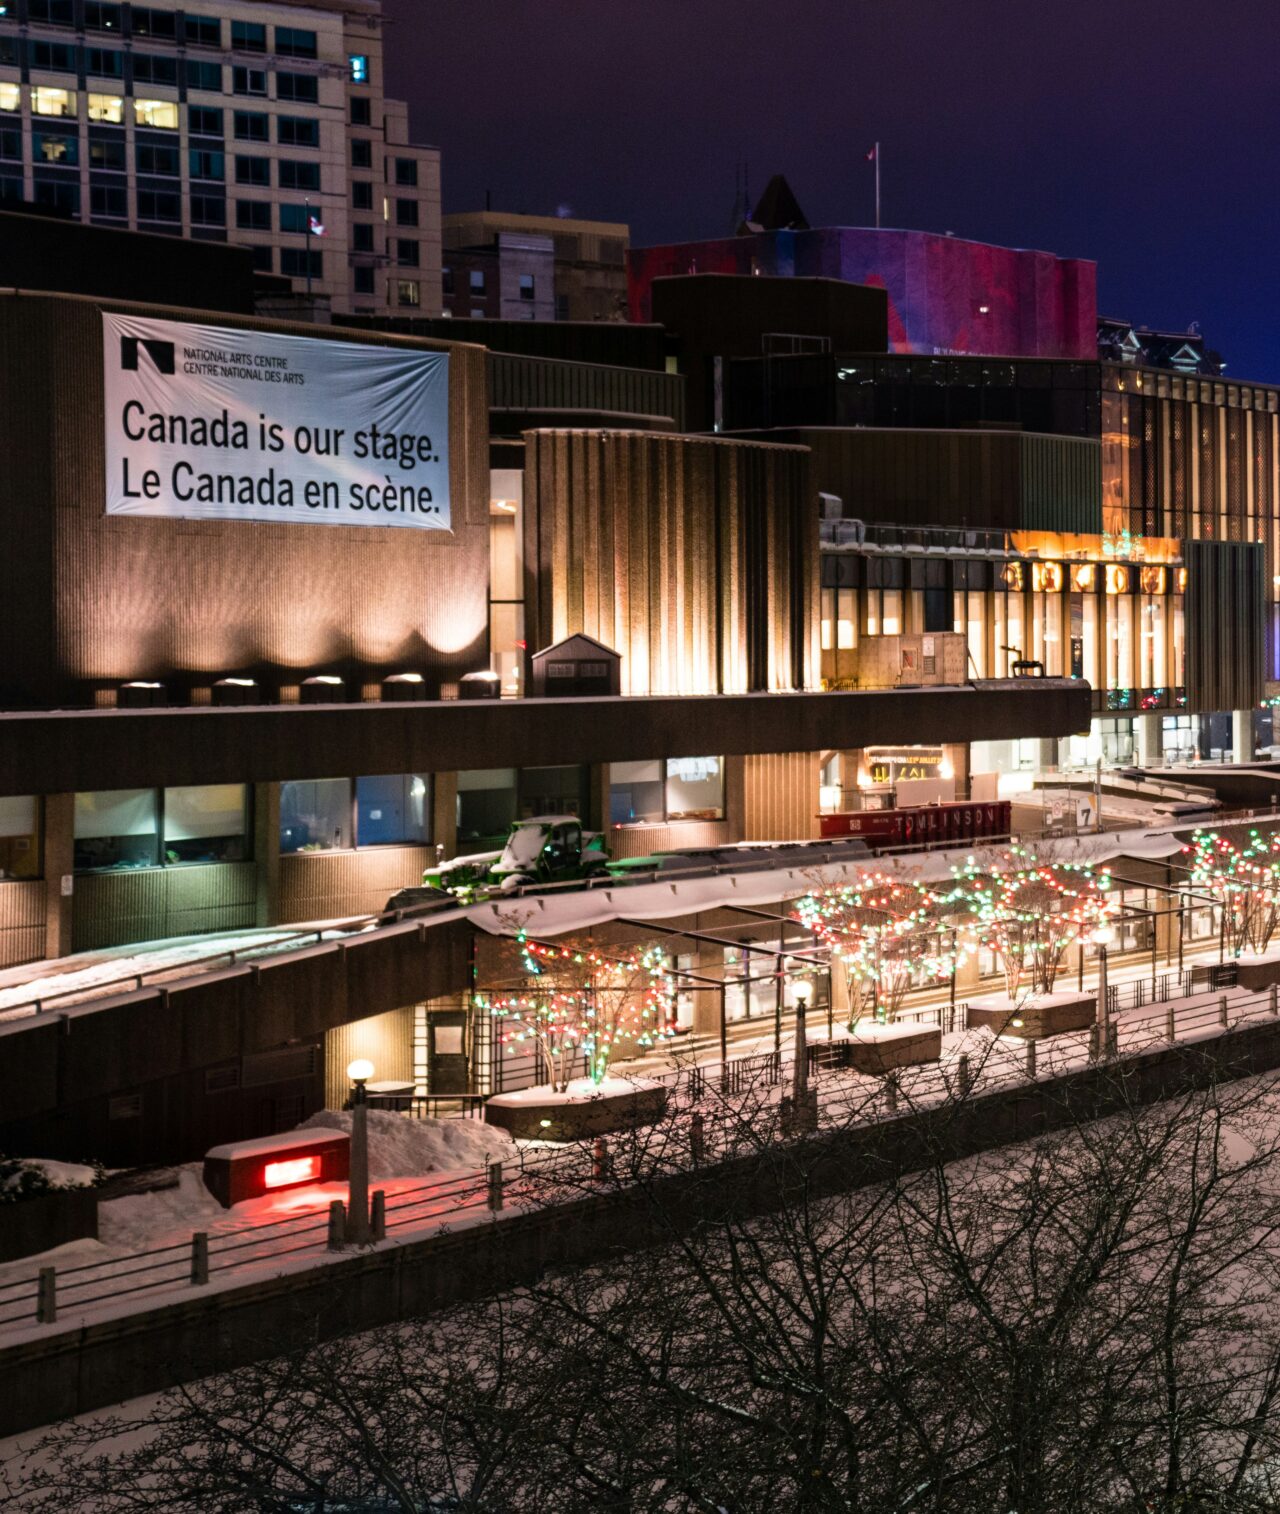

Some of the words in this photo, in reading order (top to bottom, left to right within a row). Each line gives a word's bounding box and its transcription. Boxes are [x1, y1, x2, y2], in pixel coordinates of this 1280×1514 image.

[183, 348, 228, 363] NATIONAL
[229, 352, 253, 366] ARTS
[254, 355, 288, 369] CENTRE
[183, 362, 219, 377] CENTRE
[220, 365, 263, 381] NATIONAL
[264, 370, 281, 383] DES
[282, 373, 305, 385] ARTS
[121, 399, 249, 450] Canada
[259, 413, 284, 452] is
[293, 424, 345, 456] our
[353, 423, 439, 470] stage.
[121, 457, 161, 499] Le
[171, 461, 294, 507] Canada
[303, 479, 340, 509] en
[349, 475, 440, 513] scène.
[895, 808, 994, 832] TOMLINSON
[1080, 808, 1092, 827] 7
